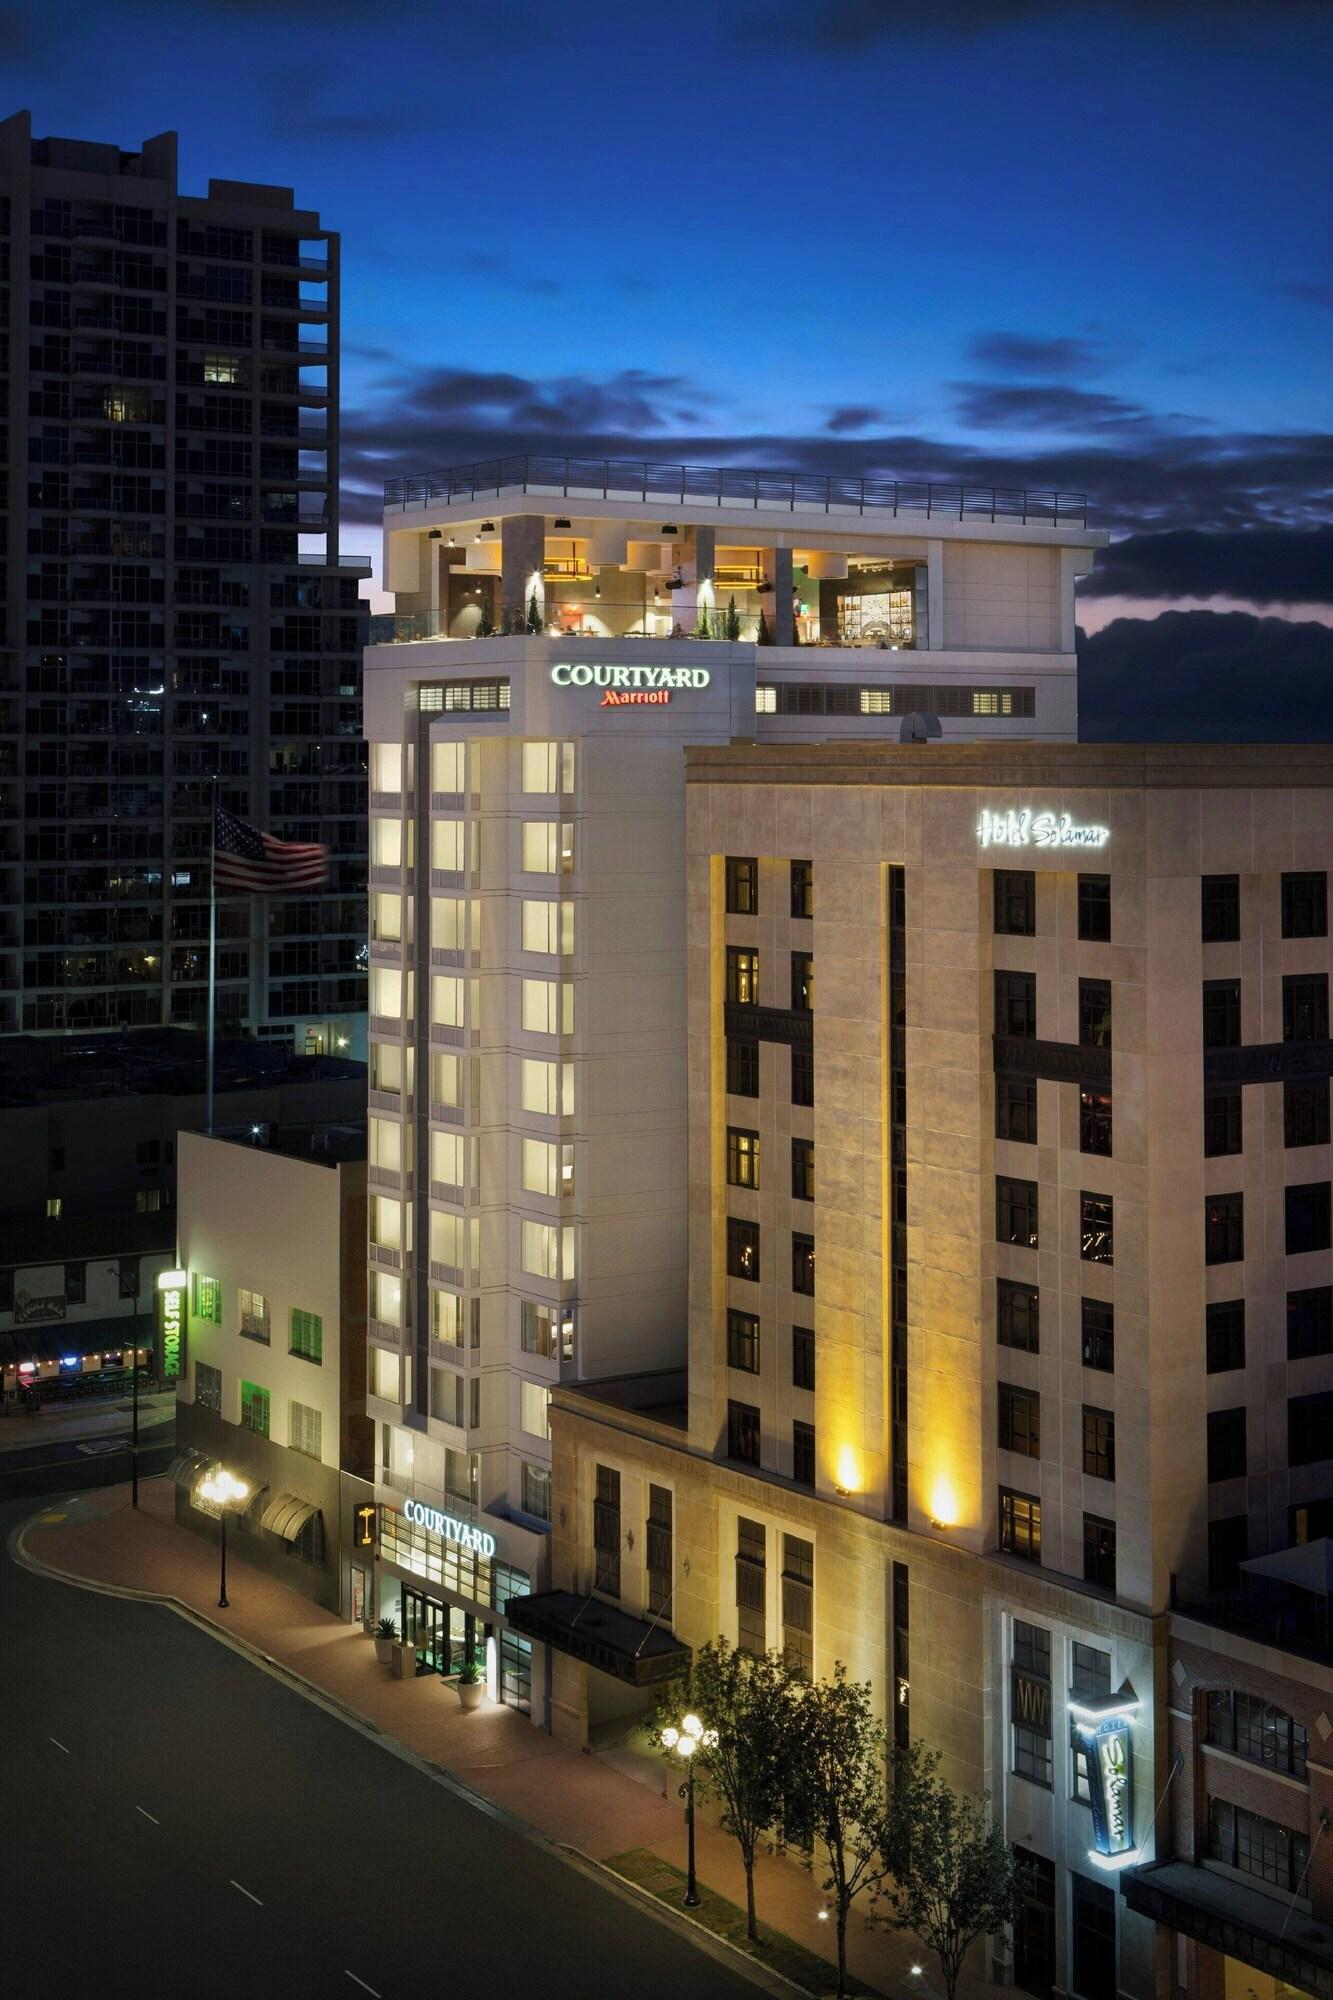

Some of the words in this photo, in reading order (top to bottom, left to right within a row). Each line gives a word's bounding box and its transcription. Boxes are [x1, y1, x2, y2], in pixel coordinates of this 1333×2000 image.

[551, 664, 711, 688] COURTYARD
[600, 690, 670, 706] Marriott
[164, 1290, 181, 1319] SELF
[164, 1320, 180, 1377] STORAGE
[404, 1499, 496, 1557] COURTYARD
[1104, 1736, 1127, 1842] Solamar
